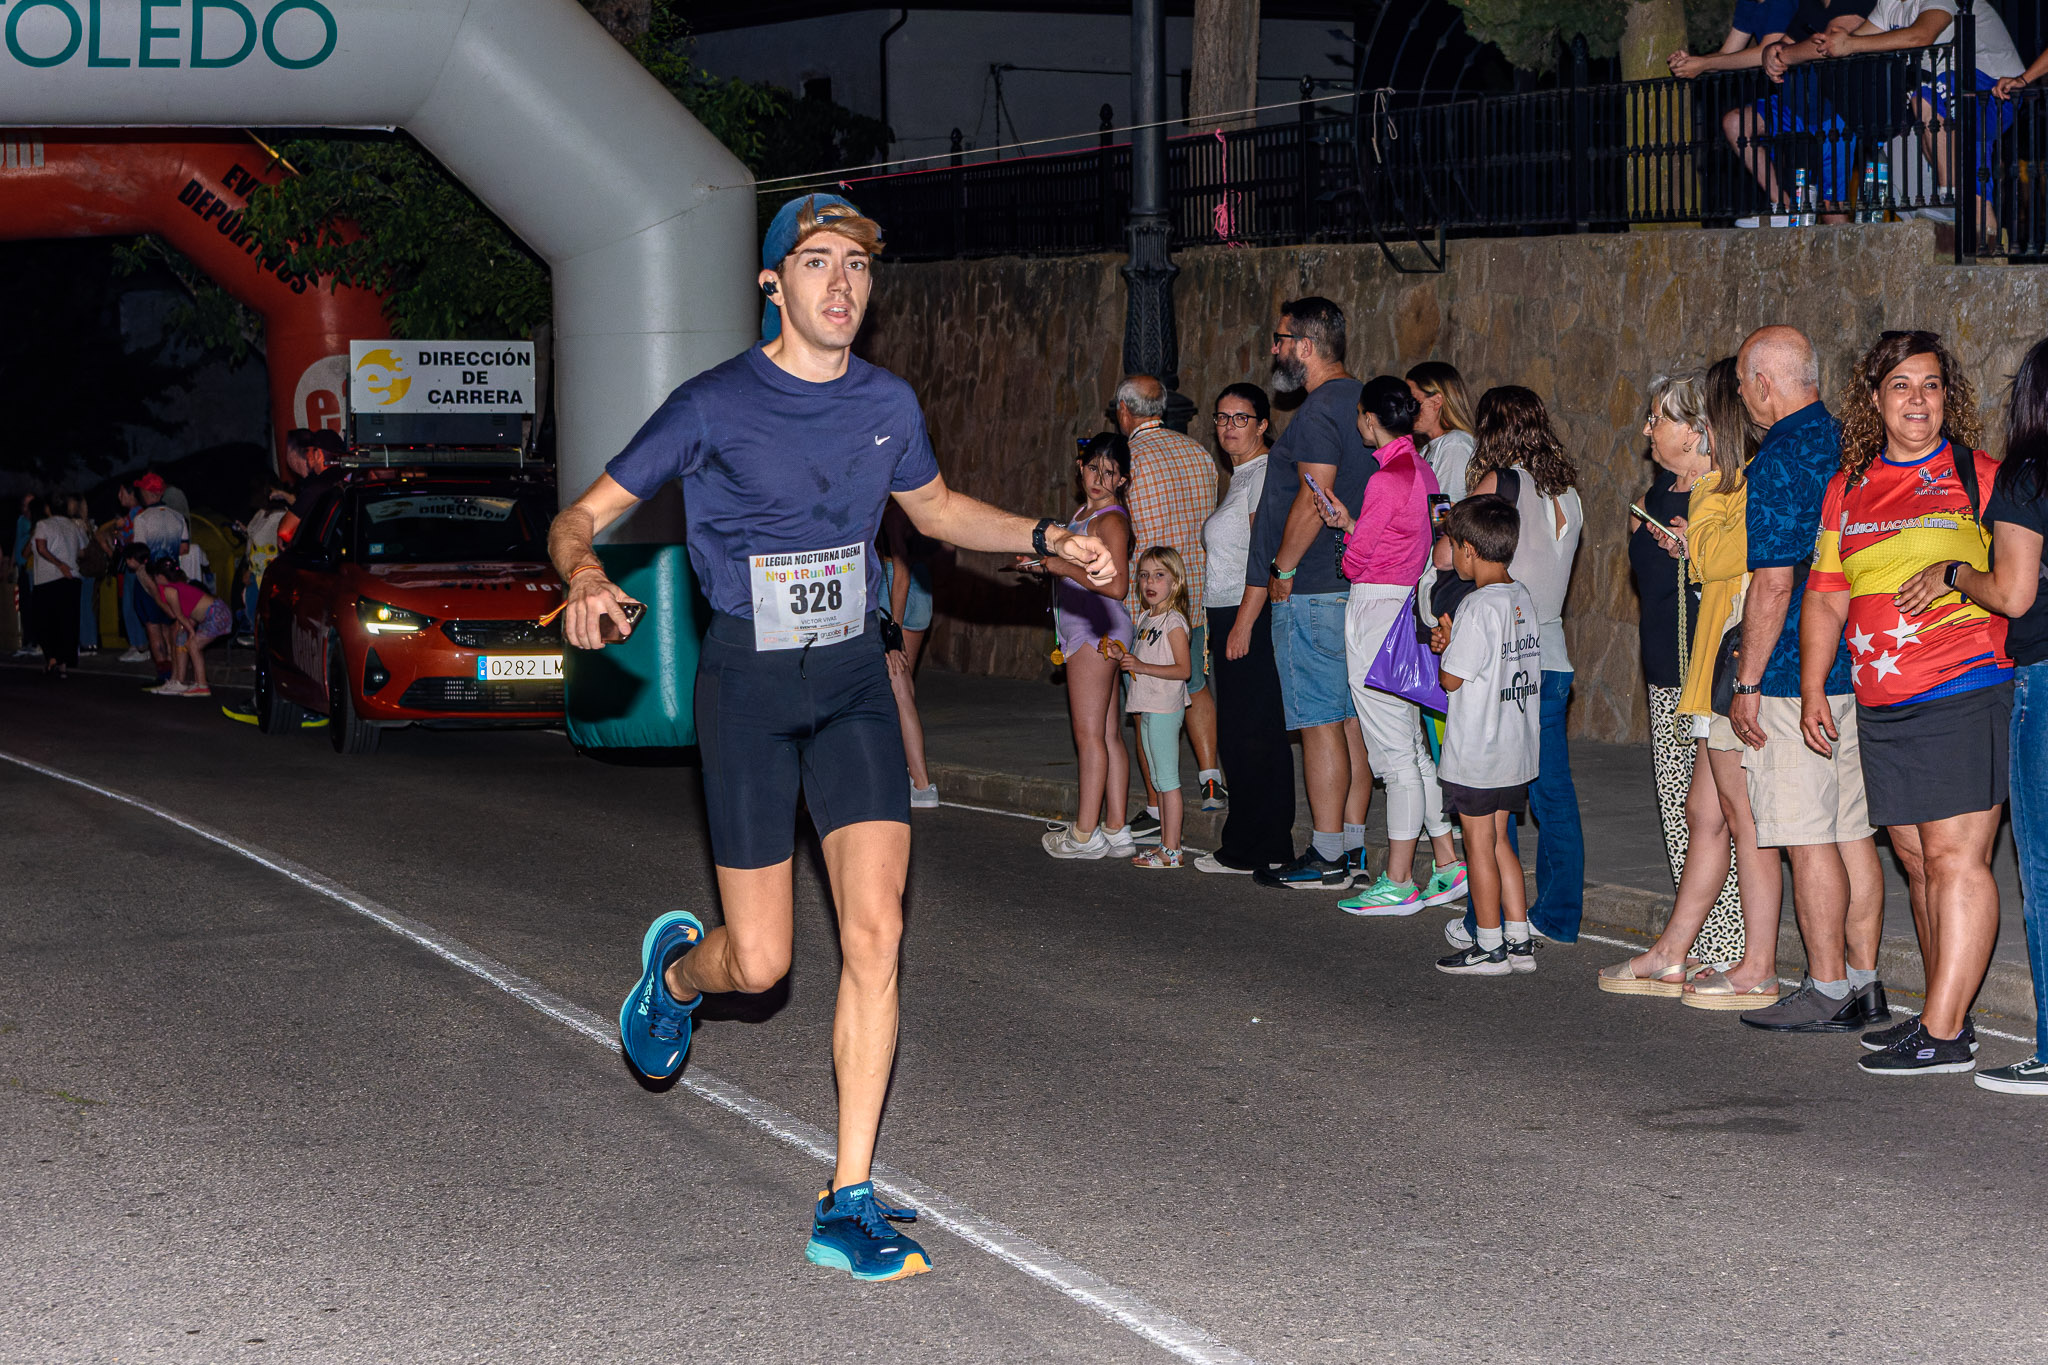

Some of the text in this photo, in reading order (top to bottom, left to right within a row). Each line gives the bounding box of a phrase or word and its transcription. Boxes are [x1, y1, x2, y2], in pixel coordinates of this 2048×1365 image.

[0, 0, 338, 70] OLEDO
[418, 347, 531, 366] DIRECCIÓN
[462, 370, 489, 385] DE
[427, 389, 524, 405] CARRERA
[1880, 518, 1922, 532] LACASA
[754, 545, 861, 568] XI LEGUA NOCTURNA UGENA
[789, 579, 843, 615] 328
[491, 660, 536, 676] 0282
[849, 1187, 870, 1199] HOKA
